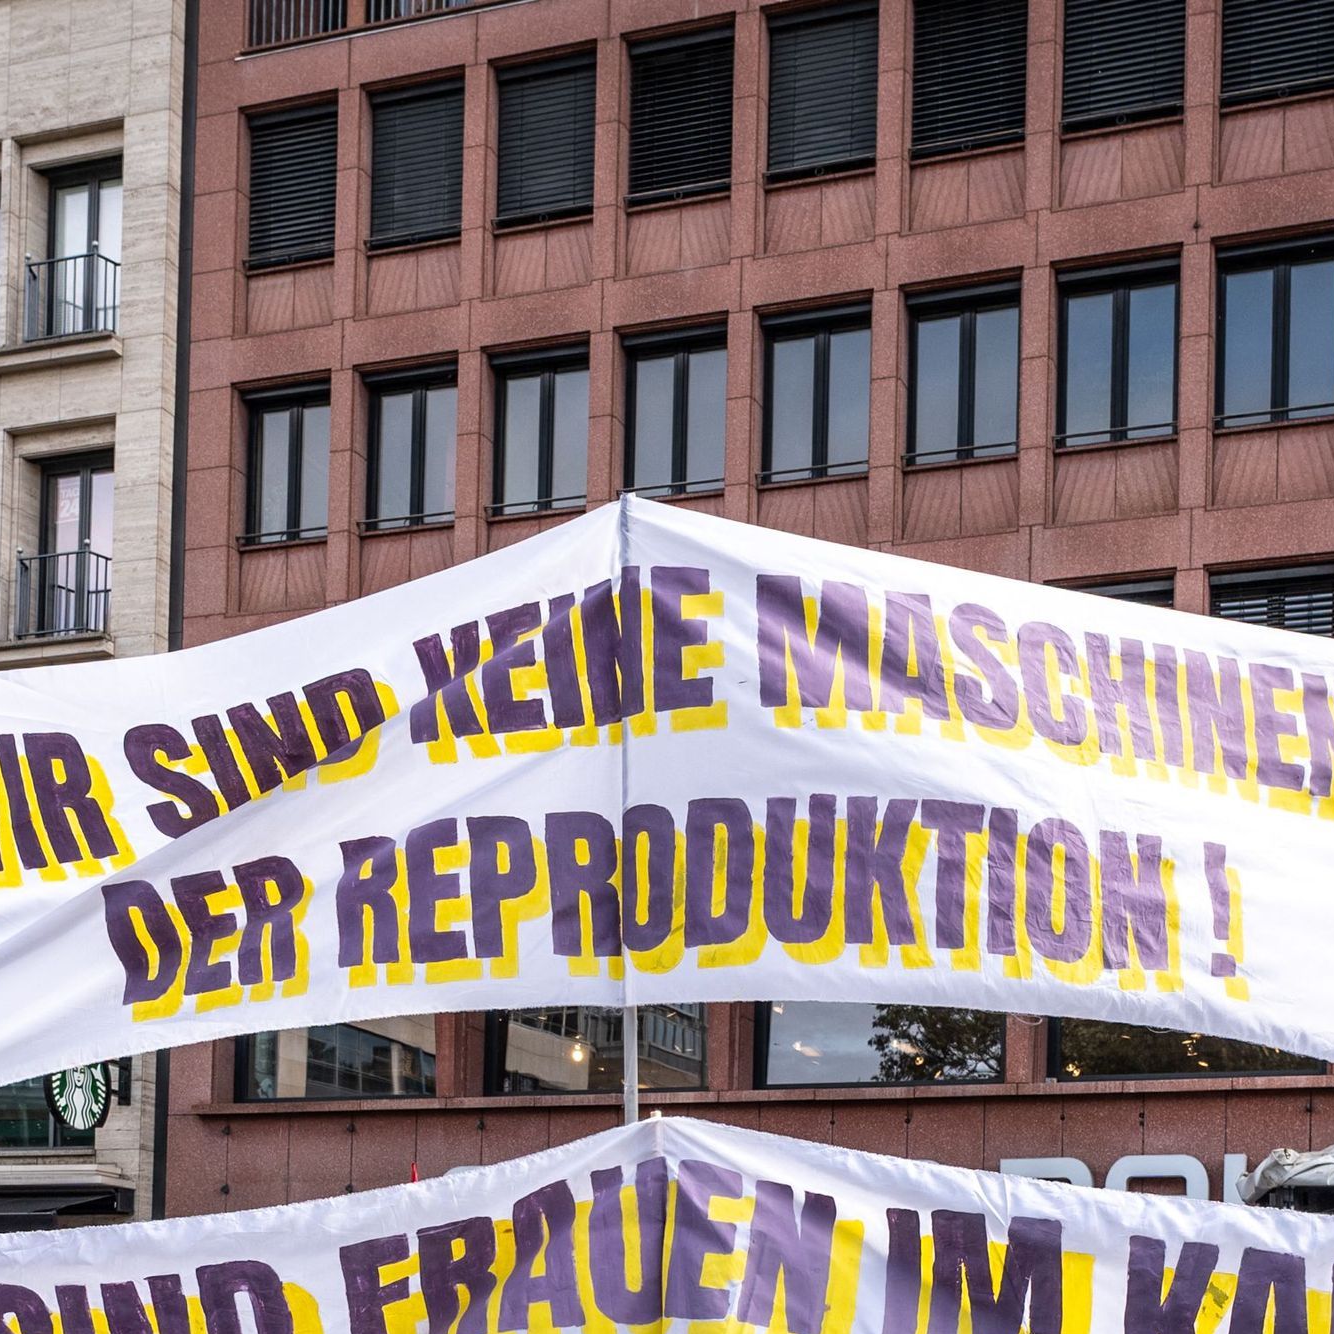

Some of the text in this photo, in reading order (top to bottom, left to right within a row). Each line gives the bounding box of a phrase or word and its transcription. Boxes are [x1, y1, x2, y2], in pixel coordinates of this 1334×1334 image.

[124, 668, 403, 839] SIND
[409, 566, 728, 763] KEINE
[102, 794, 1249, 1023] DER REPRODUKTION !
